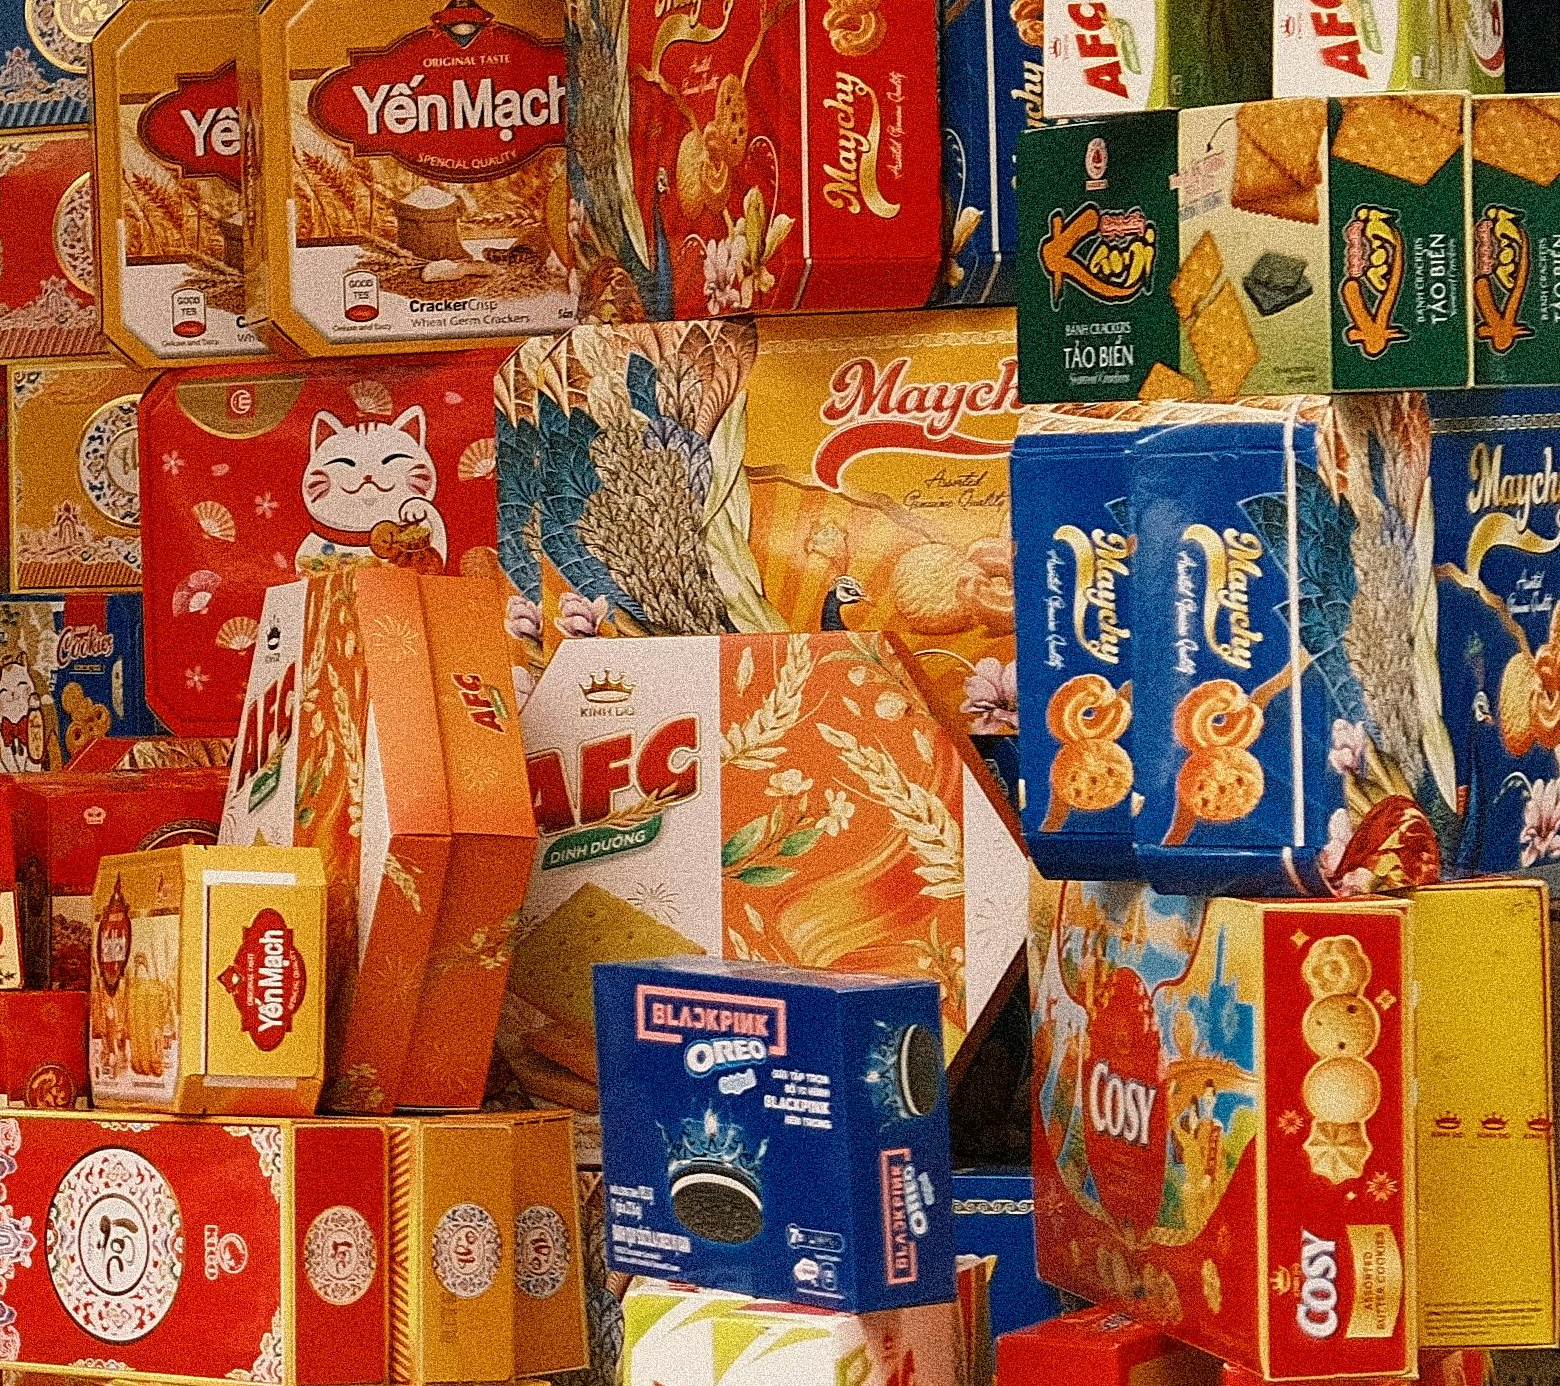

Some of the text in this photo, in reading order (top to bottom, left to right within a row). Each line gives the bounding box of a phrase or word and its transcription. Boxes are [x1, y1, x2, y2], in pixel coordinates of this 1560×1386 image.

[422, 53, 511, 68] ORIGINAL TASTE
[1067, 1, 1129, 100] AFC
[821, 70, 866, 213] Maychy
[820, 356, 1018, 426] Maych
[1091, 527, 1122, 665] Maychy
[1223, 526, 1266, 669] Maychy
[527, 715, 700, 836] AFC
[652, 1003, 770, 1035] BLACKPINK
[686, 1041, 767, 1072] OREO
[1088, 1061, 1156, 1148] COSY
